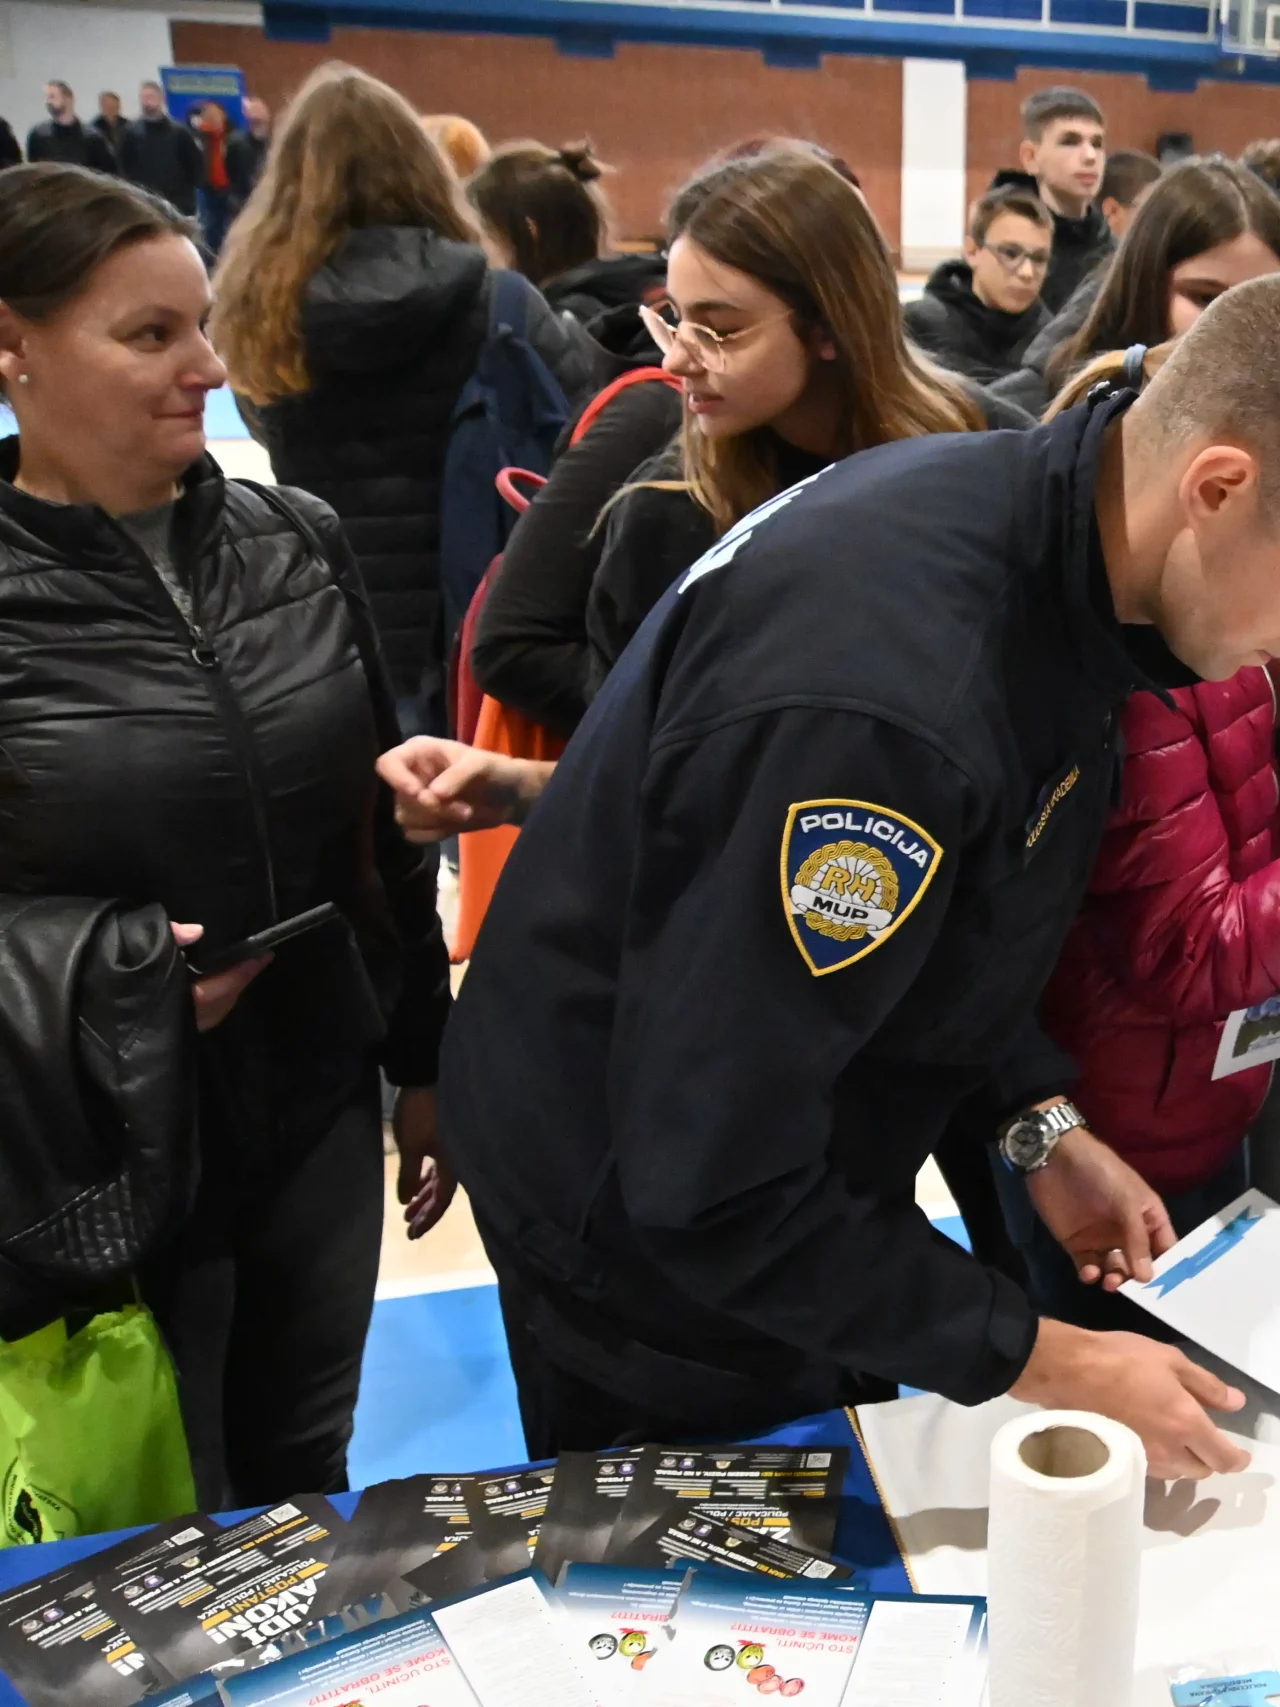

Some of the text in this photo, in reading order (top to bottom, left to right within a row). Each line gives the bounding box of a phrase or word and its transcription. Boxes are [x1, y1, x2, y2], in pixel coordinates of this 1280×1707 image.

[800, 812, 928, 868] POLICIJA
[821, 865, 876, 902] RH
[813, 896, 869, 920] MUP
[261, 1557, 316, 1587] POLICAJAC
[197, 1588, 255, 1620] POLICAJKA
[206, 1570, 327, 1644] AKON!
[230, 1575, 298, 1613] POSTANI
[241, 1596, 314, 1646] UDI
[730, 1621, 858, 1643] KOME SE OBRATITI?
[308, 1647, 446, 1706] KOME SE OBRATITI?
